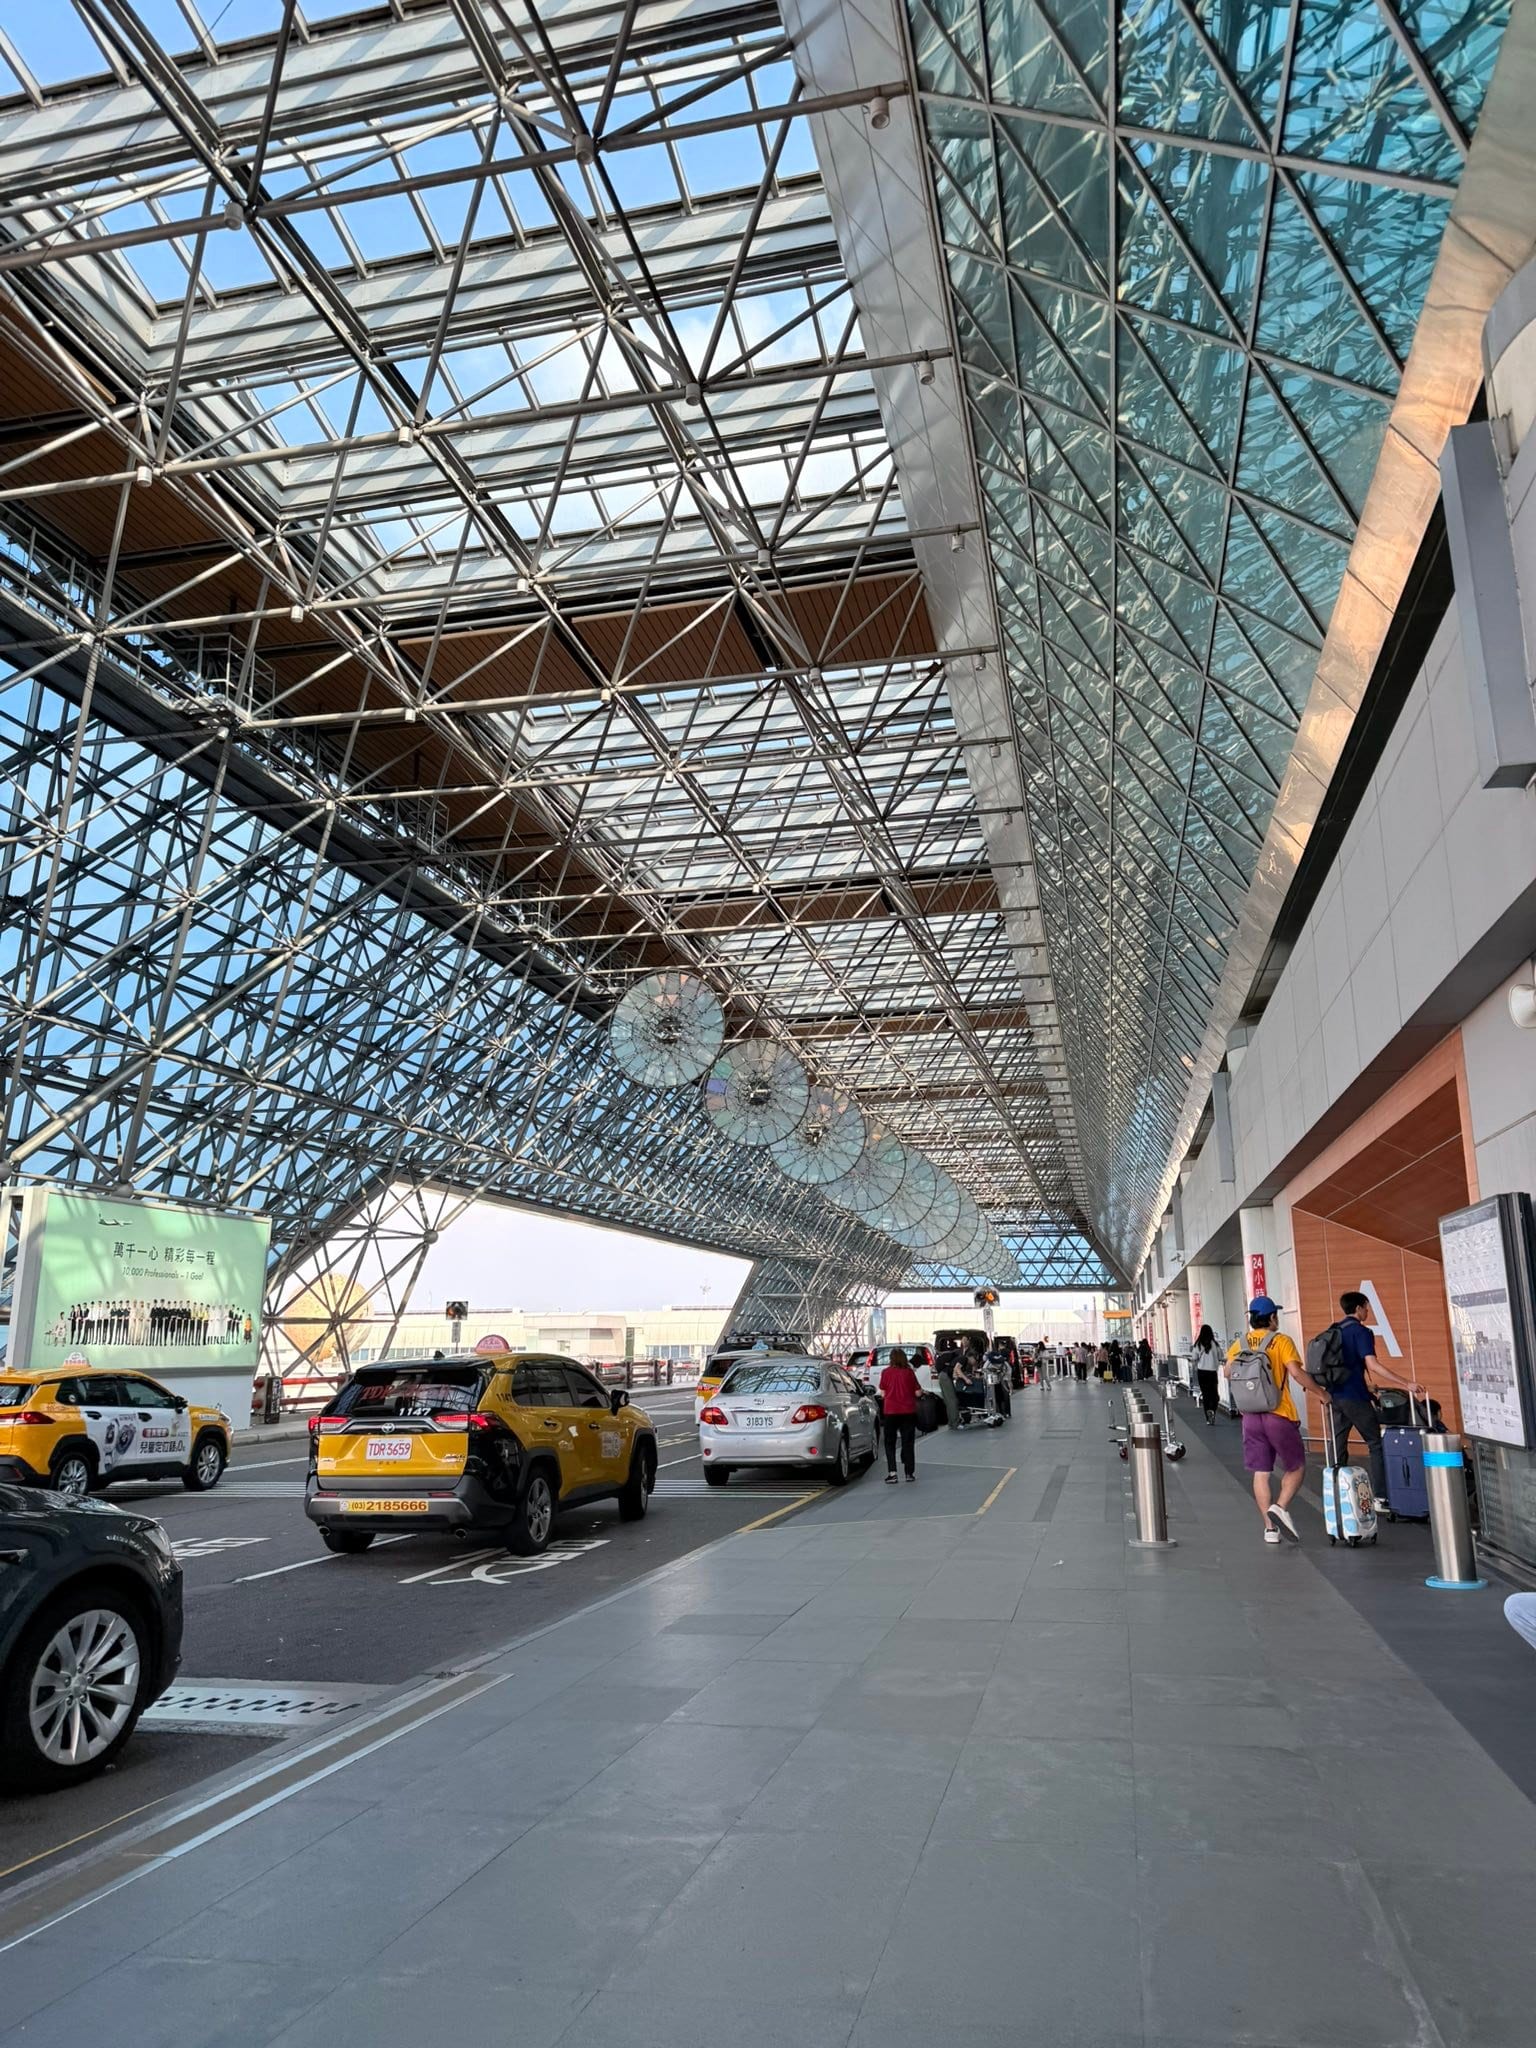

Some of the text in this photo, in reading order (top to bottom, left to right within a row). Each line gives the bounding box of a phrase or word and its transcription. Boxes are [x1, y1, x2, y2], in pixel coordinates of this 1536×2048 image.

[113, 1241, 216, 1266] 萬千一心 精彩每一程
[190, 1272, 205, 1281] Goal
[1359, 1279, 1404, 1358] A
[399, 1407, 432, 1417] 1147
